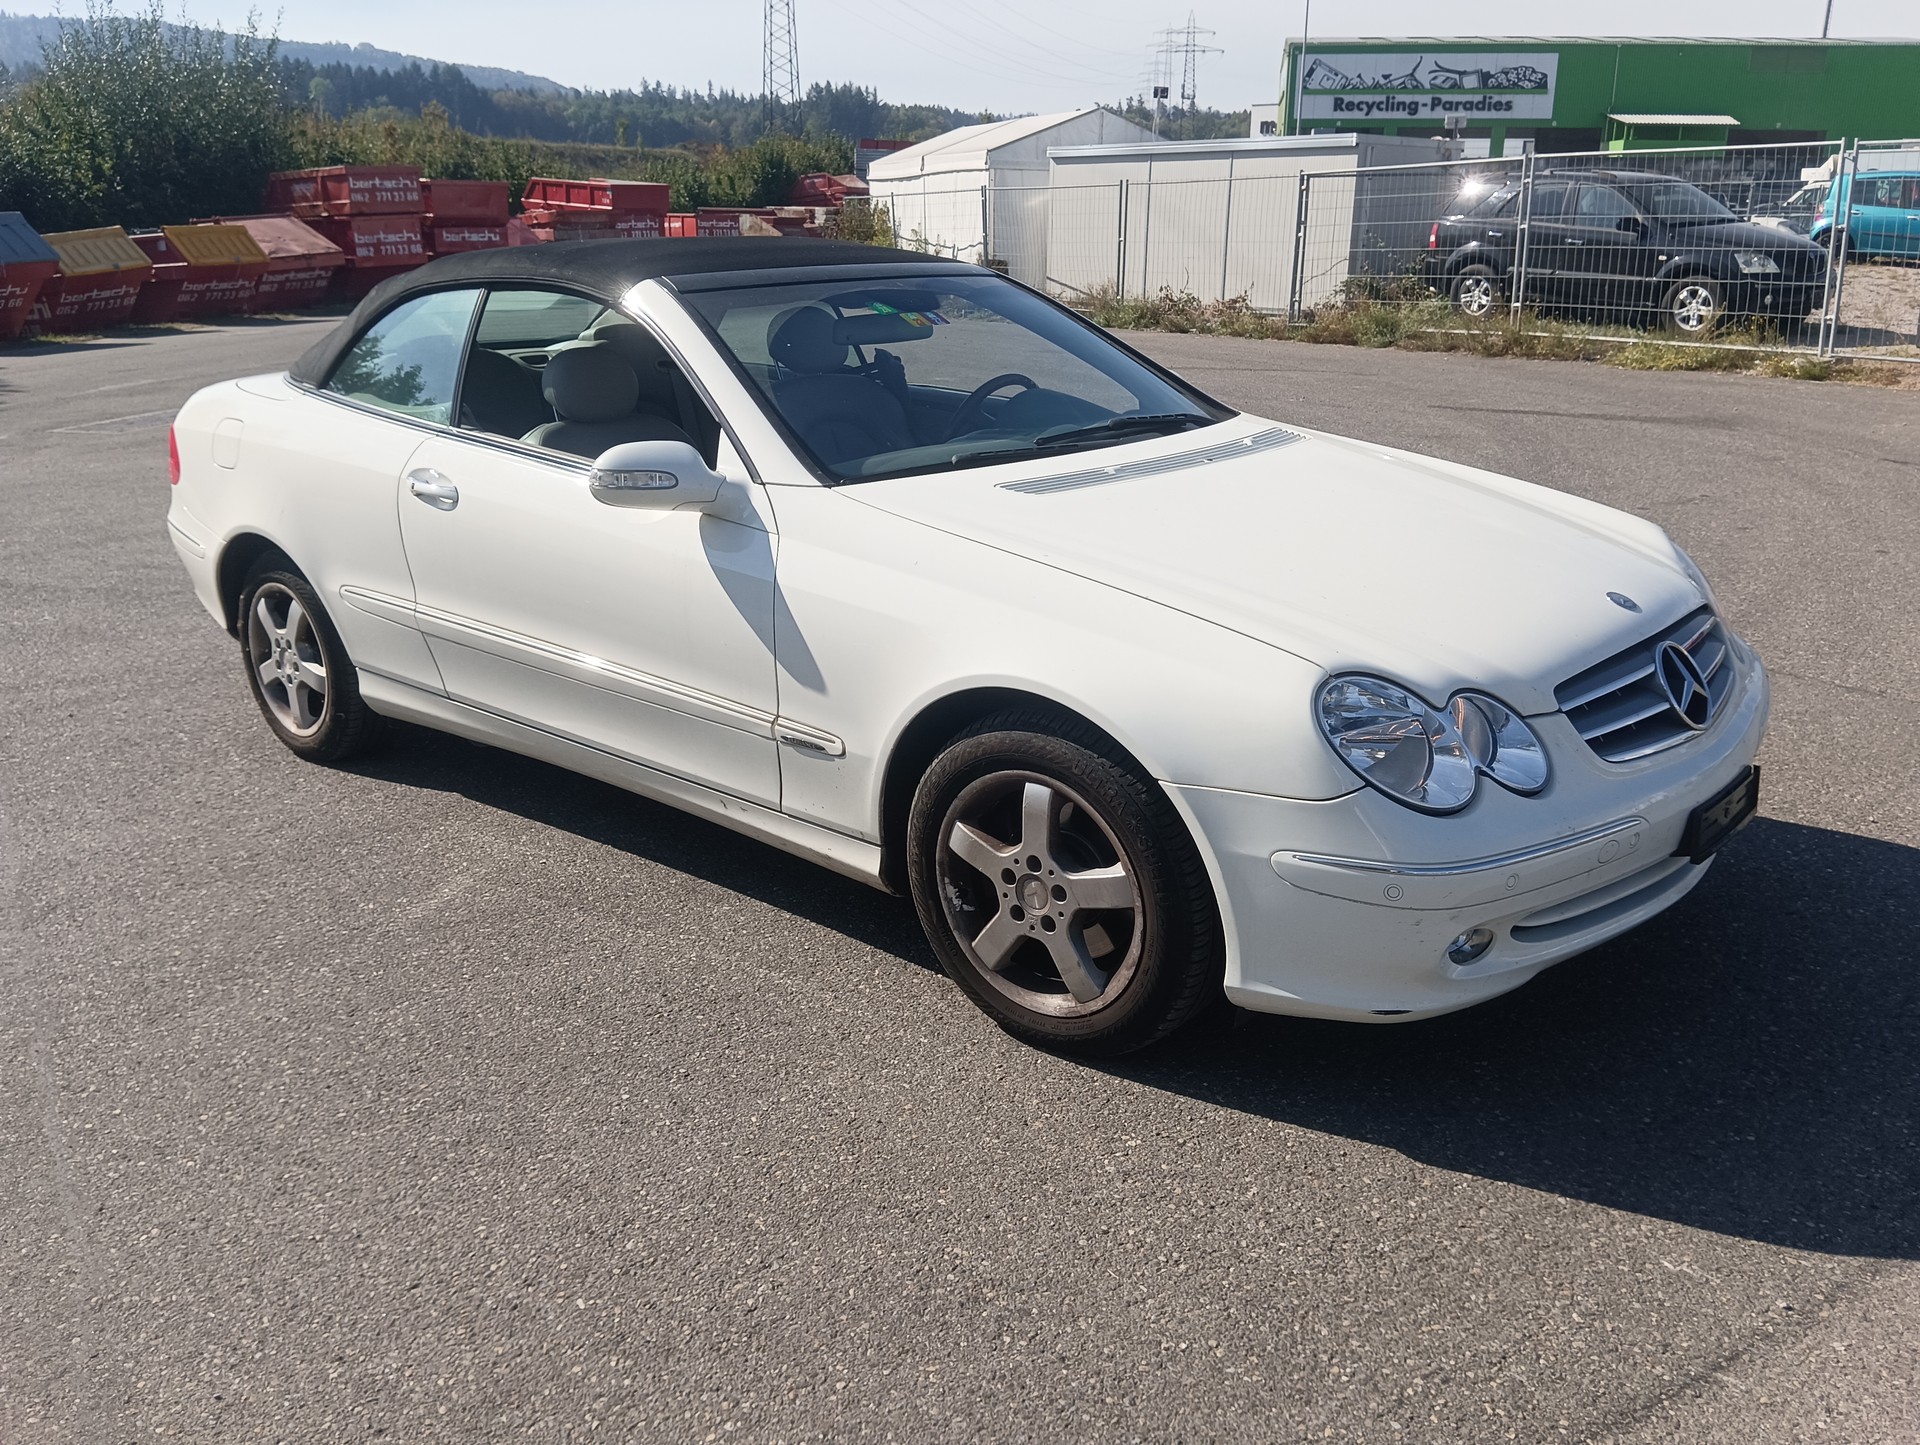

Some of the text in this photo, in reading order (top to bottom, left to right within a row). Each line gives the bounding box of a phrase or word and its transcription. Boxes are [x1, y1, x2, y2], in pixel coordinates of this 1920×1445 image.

[1333, 96, 1513, 116] Recycling-Paradies
[349, 175, 418, 189] bertschi
[354, 229, 421, 244] bertschi
[442, 228, 500, 242] bertschi
[262, 267, 333, 281] bertschi
[182, 276, 257, 291] bertschi
